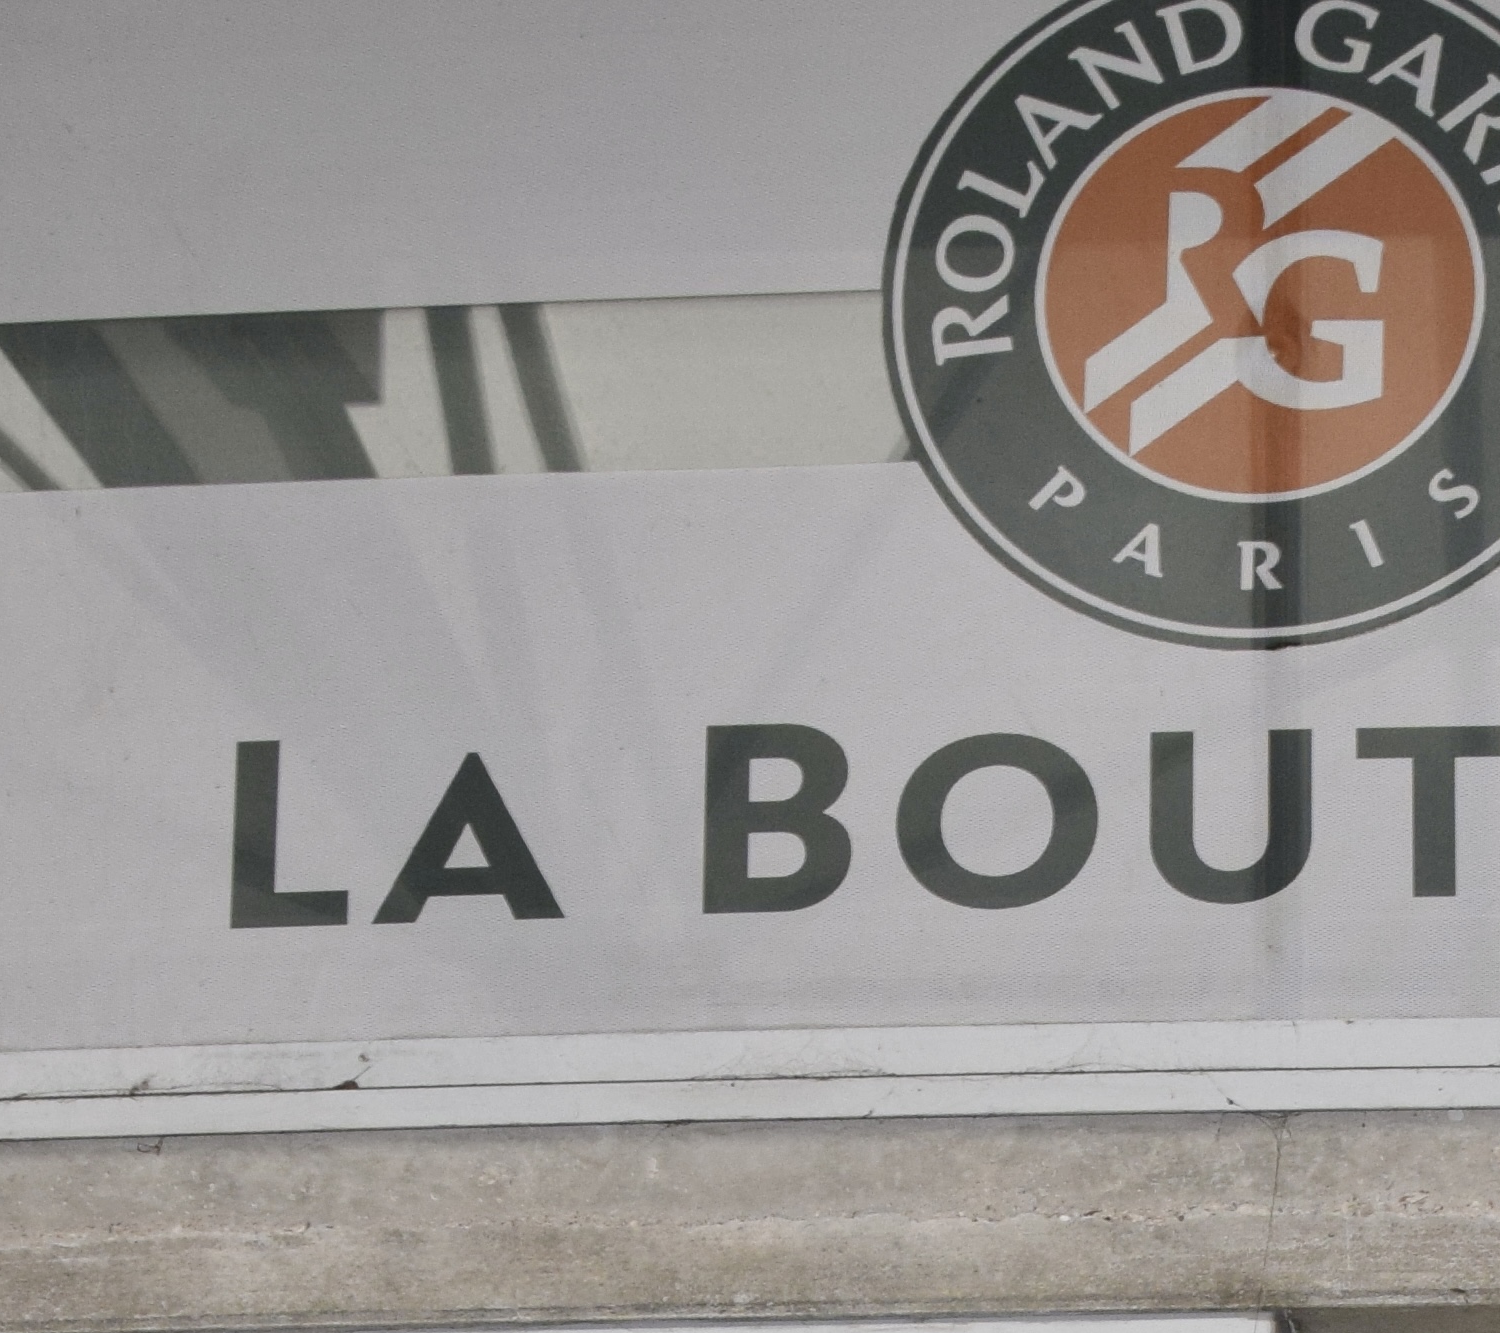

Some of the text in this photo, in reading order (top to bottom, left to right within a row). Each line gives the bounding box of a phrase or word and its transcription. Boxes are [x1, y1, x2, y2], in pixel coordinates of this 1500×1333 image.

[930, 0, 1243, 367] ROLAND
[1028, 465, 1481, 592] PARIS
[229, 739, 566, 929] LA
